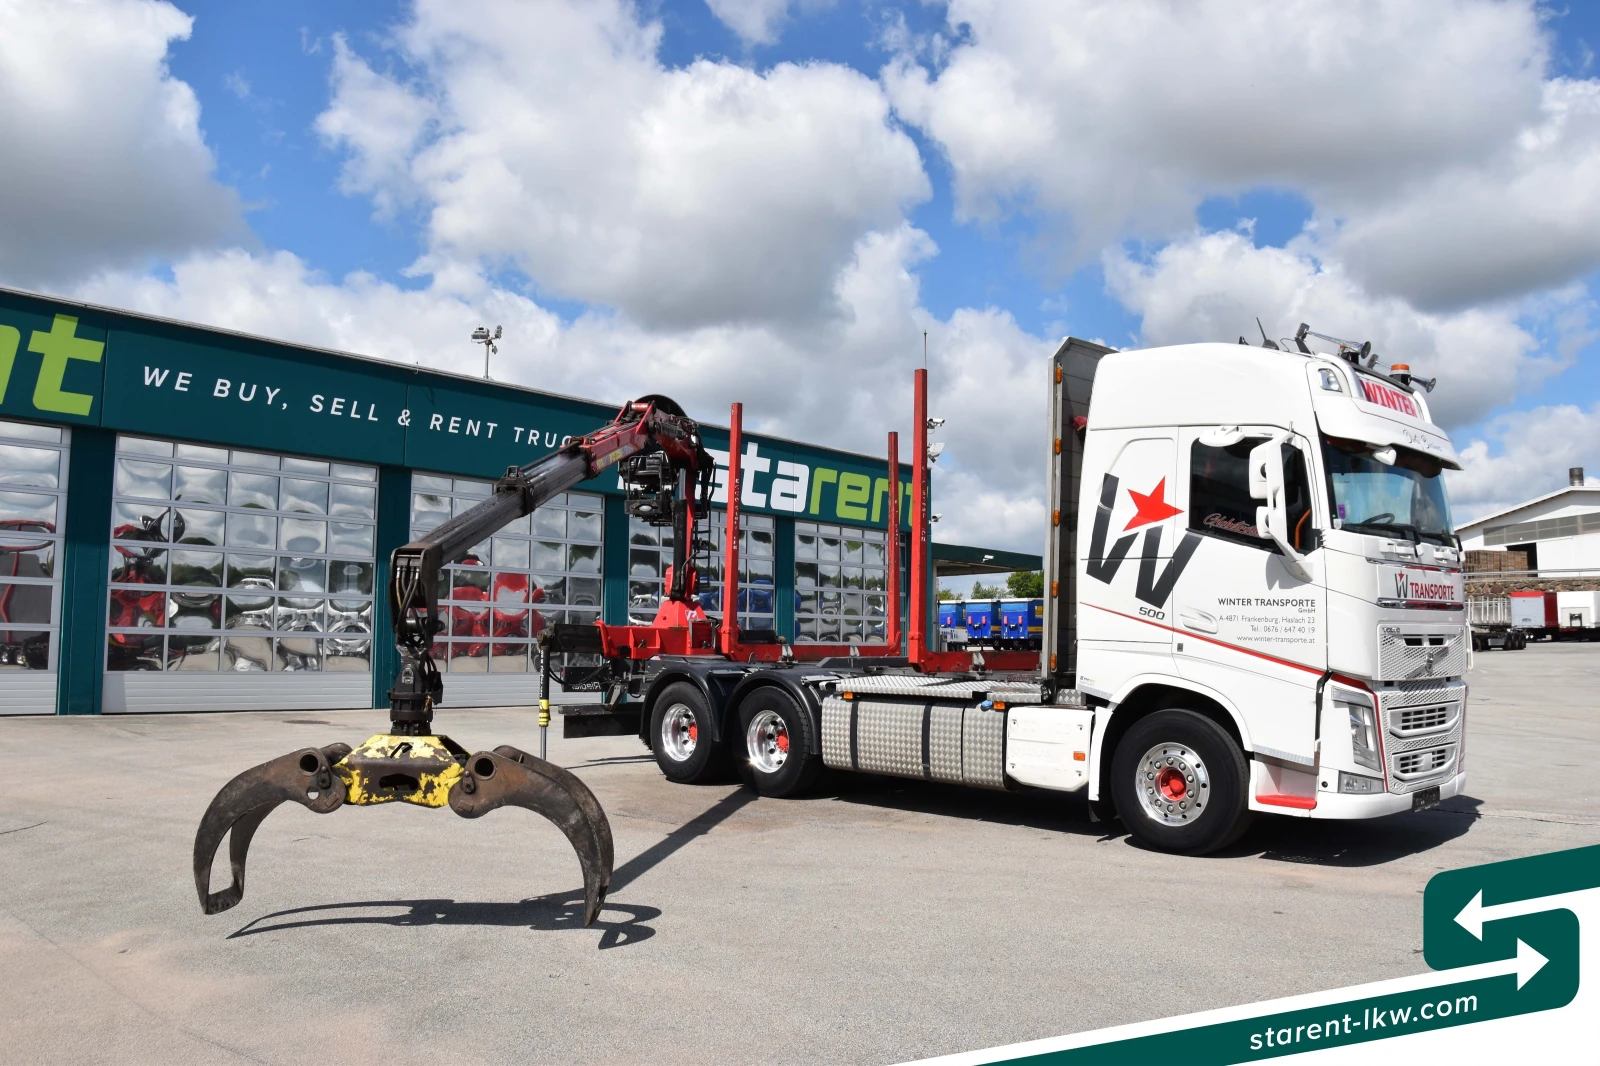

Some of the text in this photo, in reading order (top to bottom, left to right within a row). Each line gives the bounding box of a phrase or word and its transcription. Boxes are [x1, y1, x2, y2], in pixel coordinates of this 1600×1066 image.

[0, 313, 105, 416] t
[143, 365, 193, 392] WE
[213, 378, 289, 411] BUY,
[309, 394, 379, 422] SELL
[397, 409, 411, 427] &
[429, 413, 498, 440] RENT
[1359, 379, 1418, 418] WINTER
[1409, 582, 1455, 601] TRANSPORTE
[1218, 598, 1315, 607] WINTER TRANSPORTE
[1138, 606, 1166, 621] 500
[1241, 616, 1281, 625] Frankenburg,
[1281, 616, 1306, 624] Haslach
[1307, 616, 1316, 624] 23
[1263, 625, 1279, 633] 0676
[1284, 625, 1296, 633] 647
[1297, 625, 1306, 633] 40
[1307, 626, 1316, 634] 19
[1237, 635, 1315, 644] www.winter-transporte.at
